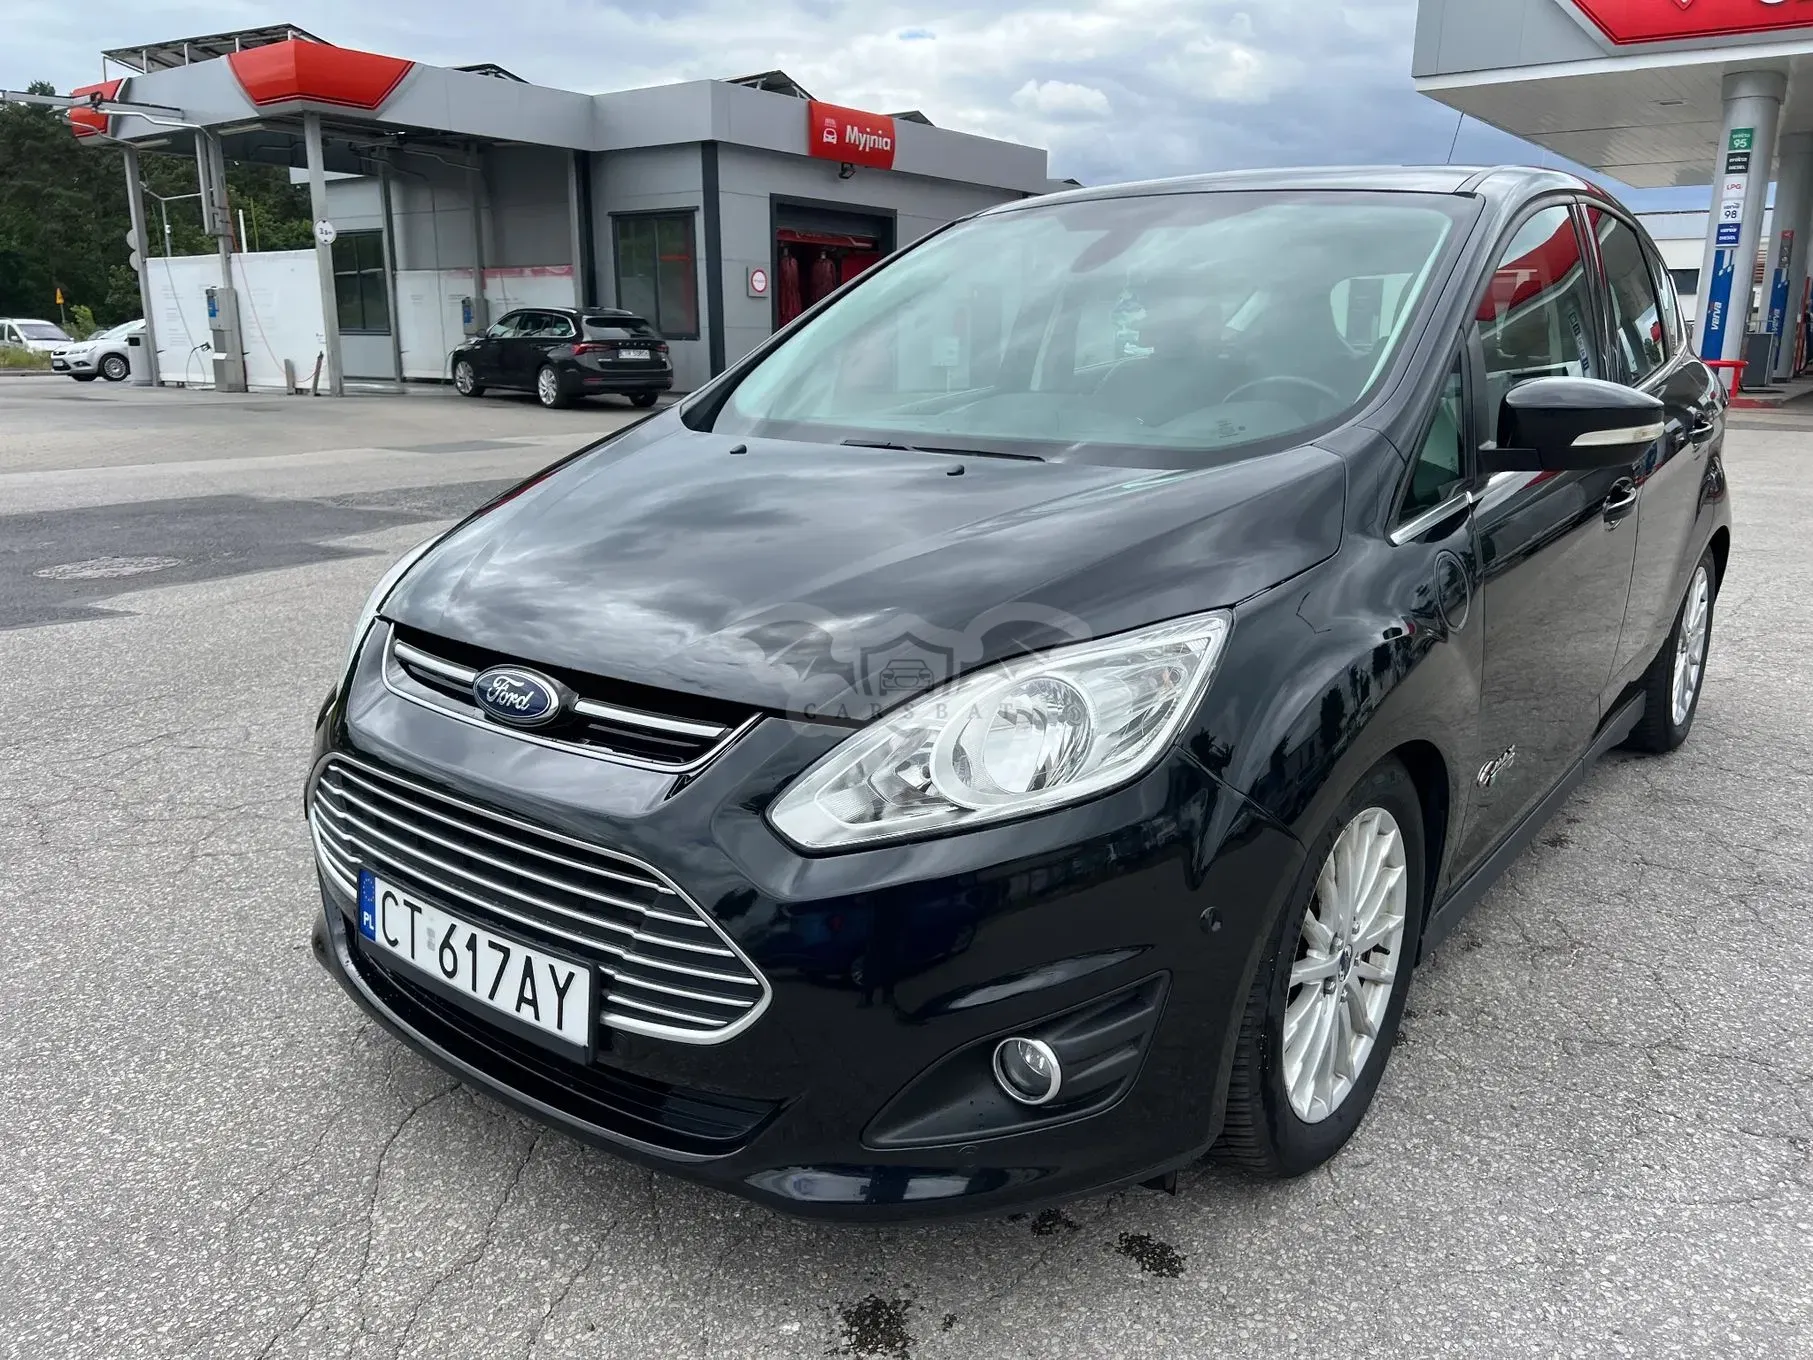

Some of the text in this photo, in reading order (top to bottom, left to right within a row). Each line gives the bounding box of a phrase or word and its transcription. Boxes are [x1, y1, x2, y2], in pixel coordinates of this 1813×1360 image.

[845, 124, 891, 152] Myjnia
[1733, 138, 1747, 148] 95
[1724, 210, 1737, 219] 98
[1711, 301, 1722, 330] verva
[486, 675, 535, 711] Ford
[363, 911, 375, 931] PL
[382, 890, 576, 1031] CT 617AY
